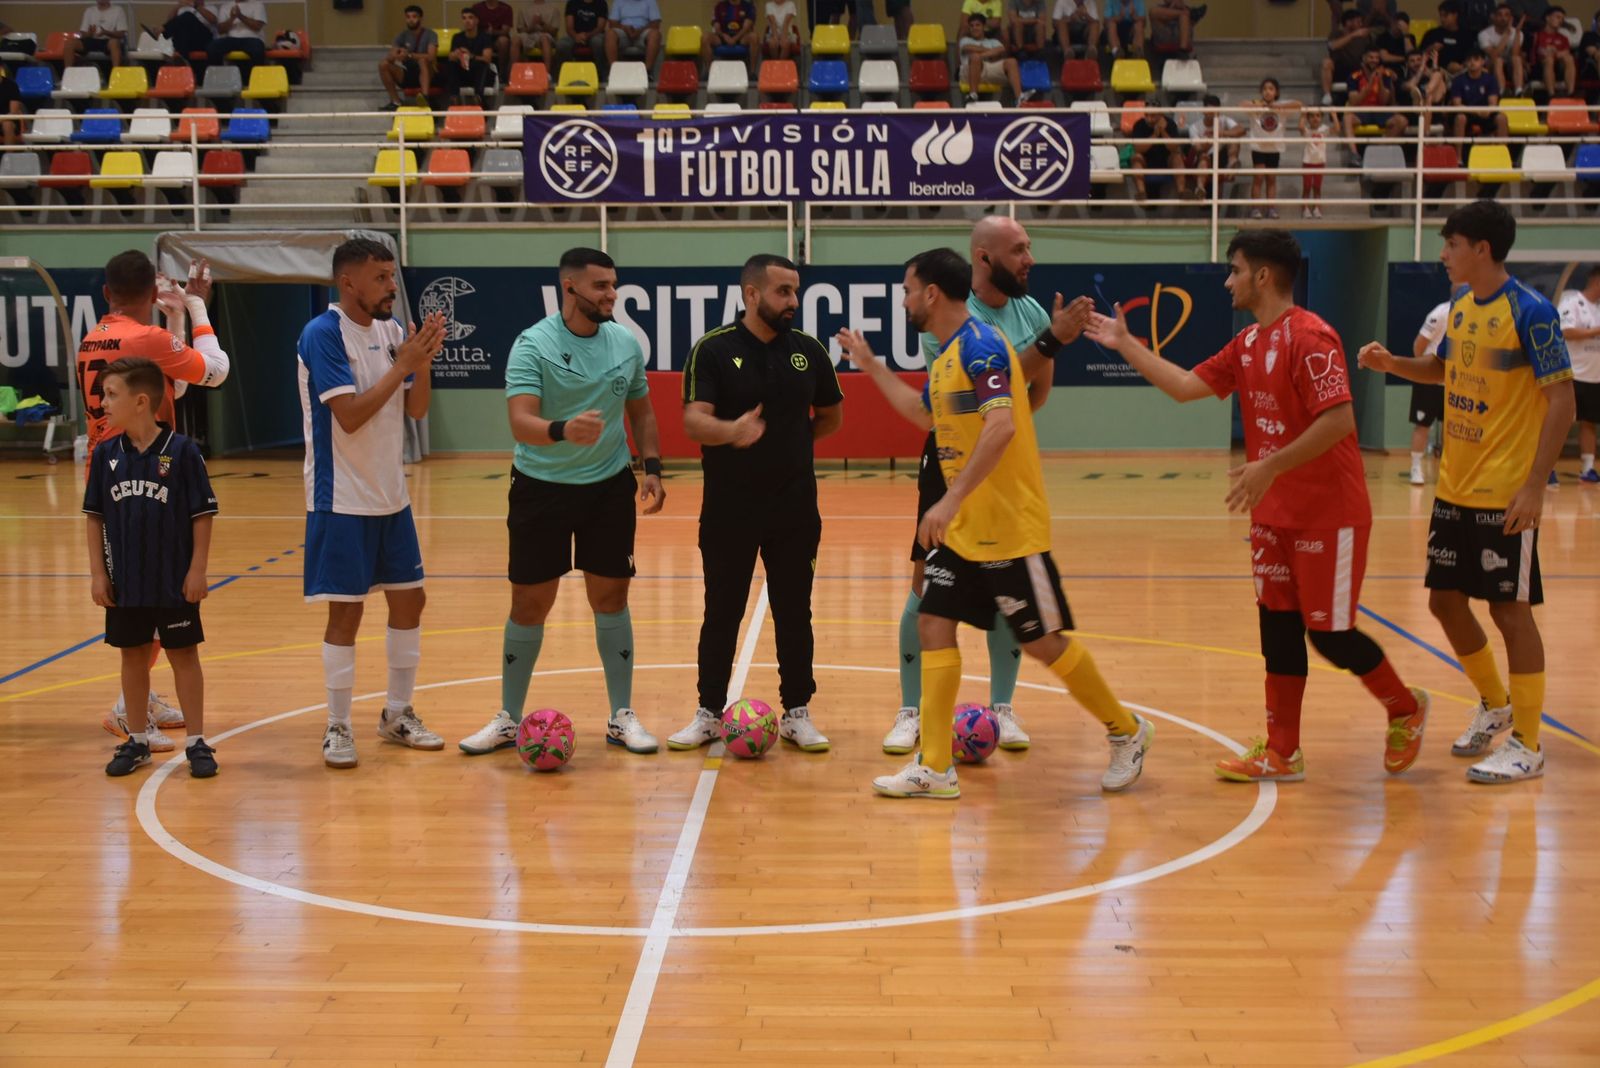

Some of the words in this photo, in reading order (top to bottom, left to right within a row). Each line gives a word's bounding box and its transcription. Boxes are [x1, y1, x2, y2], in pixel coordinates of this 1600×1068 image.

[680, 118, 889, 145] DIVISIÓN
[564, 145, 593, 157] RF
[1019, 142, 1048, 155] RF
[564, 160, 593, 172] EF
[680, 143, 800, 197] FÚTBOL
[811, 149, 891, 196] SALA
[1019, 158, 1048, 170] EF
[909, 181, 975, 196] Iberdrola
[987, 375, 1002, 389] C
[110, 479, 169, 504] CEUTA
